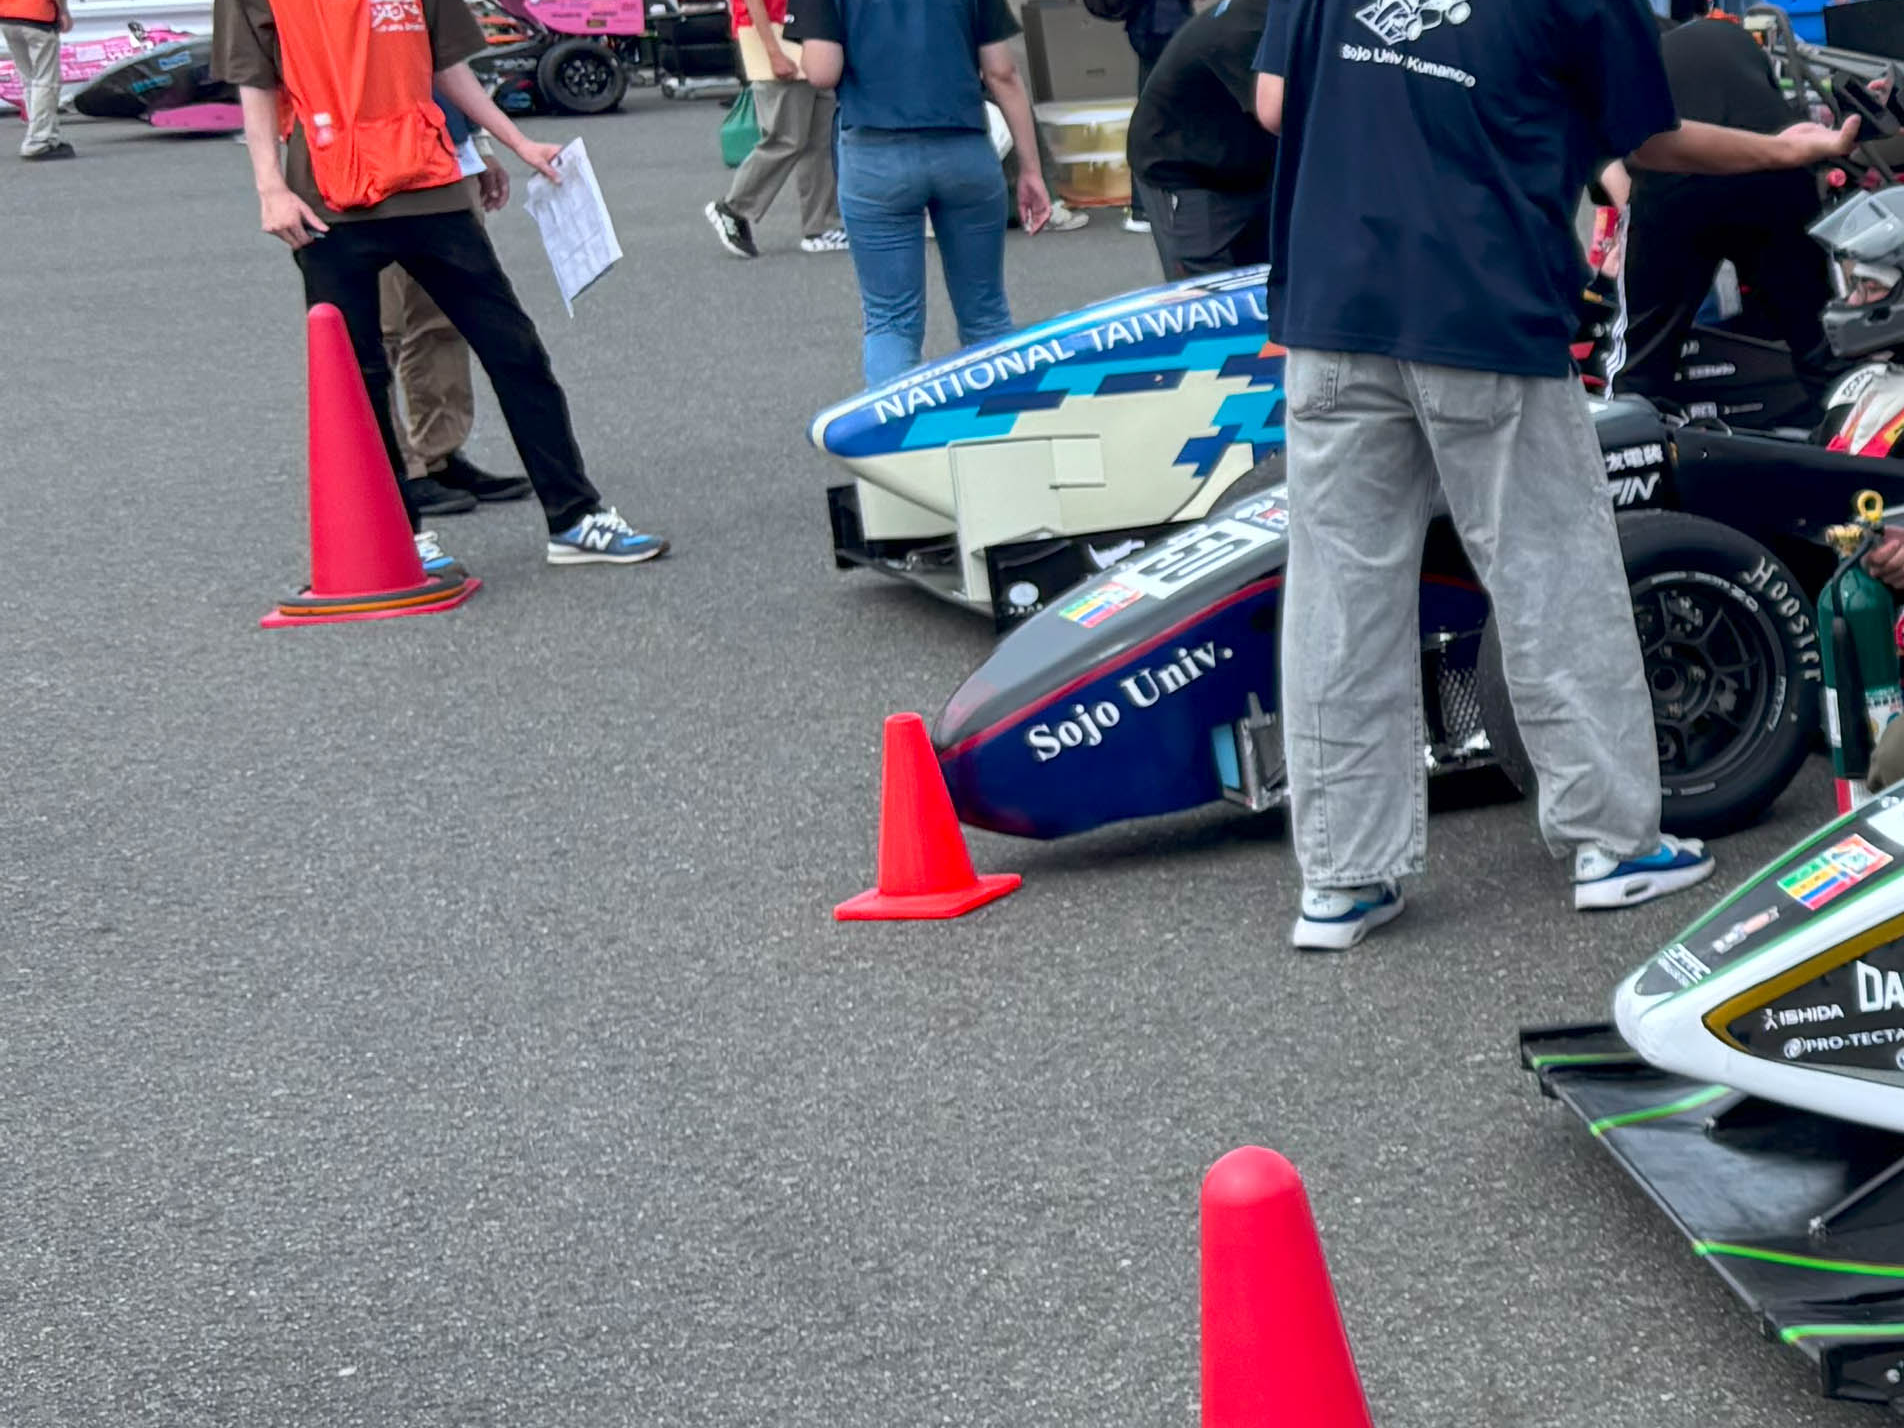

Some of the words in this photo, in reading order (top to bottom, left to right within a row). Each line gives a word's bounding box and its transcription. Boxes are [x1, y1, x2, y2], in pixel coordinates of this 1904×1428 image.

[1341, 44, 1372, 63] Sojo
[874, 339, 1075, 425] NATIONAL
[1086, 293, 1240, 356] TAIWAN
[1606, 443, 1664, 473] 友電装
[1742, 555, 1823, 684] Hoosier
[1024, 695, 1122, 763] Sojo
[1118, 637, 1236, 710] Univ.
[1778, 1003, 1846, 1026] ISHIDA
